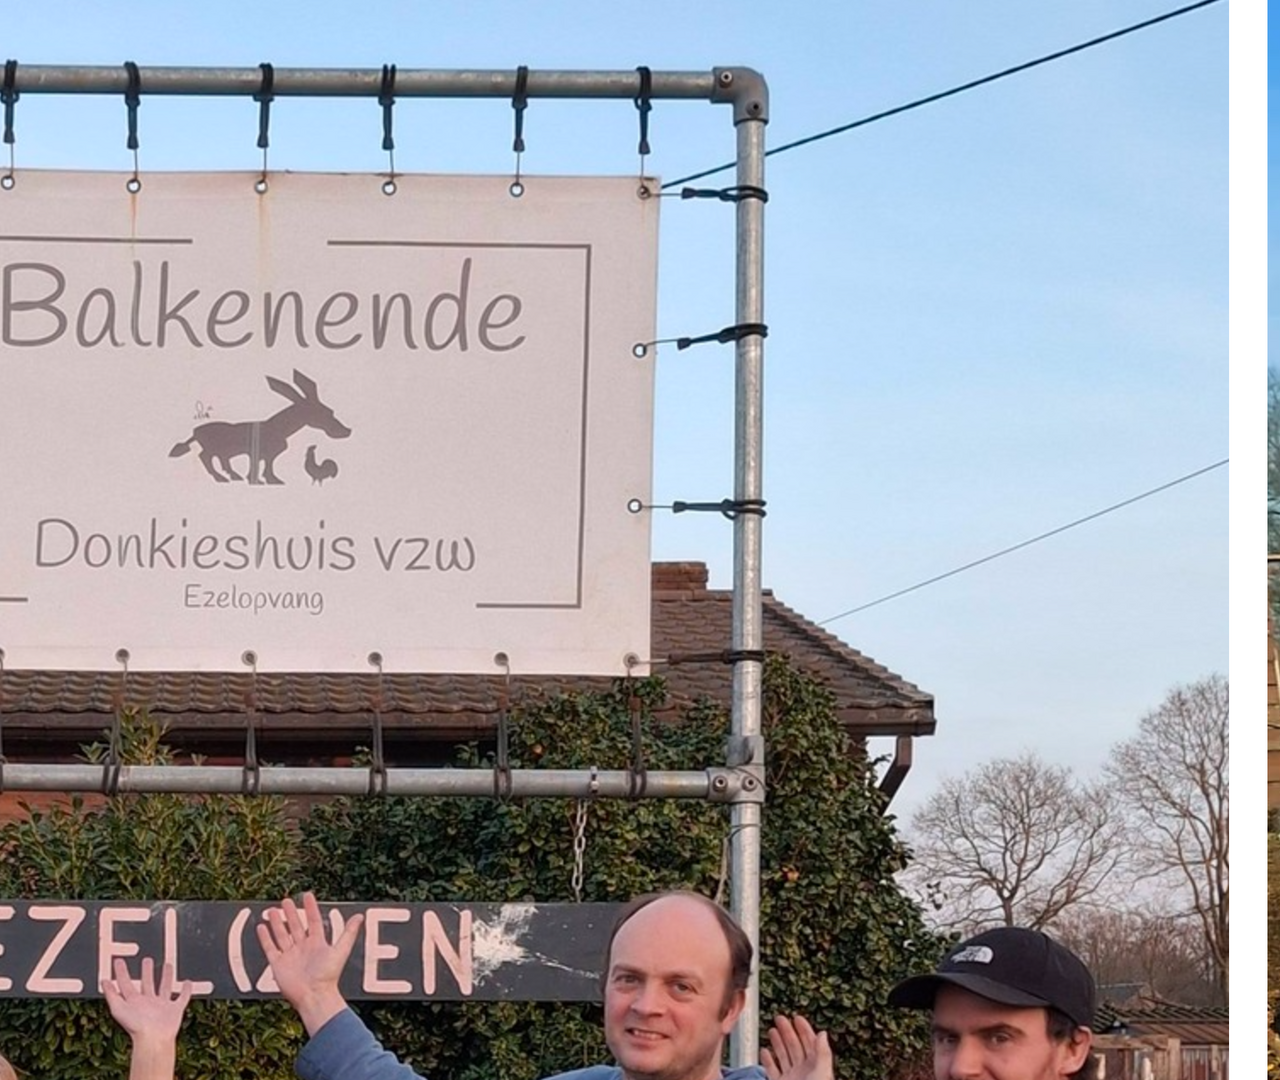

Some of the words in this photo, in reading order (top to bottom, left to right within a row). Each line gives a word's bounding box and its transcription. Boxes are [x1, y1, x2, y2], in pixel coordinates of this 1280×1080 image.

[2, 257, 526, 352] Balkenende
[35, 517, 356, 571] Donkieshuis
[373, 536, 475, 571] vzw
[184, 584, 324, 616] Ezelopvang
